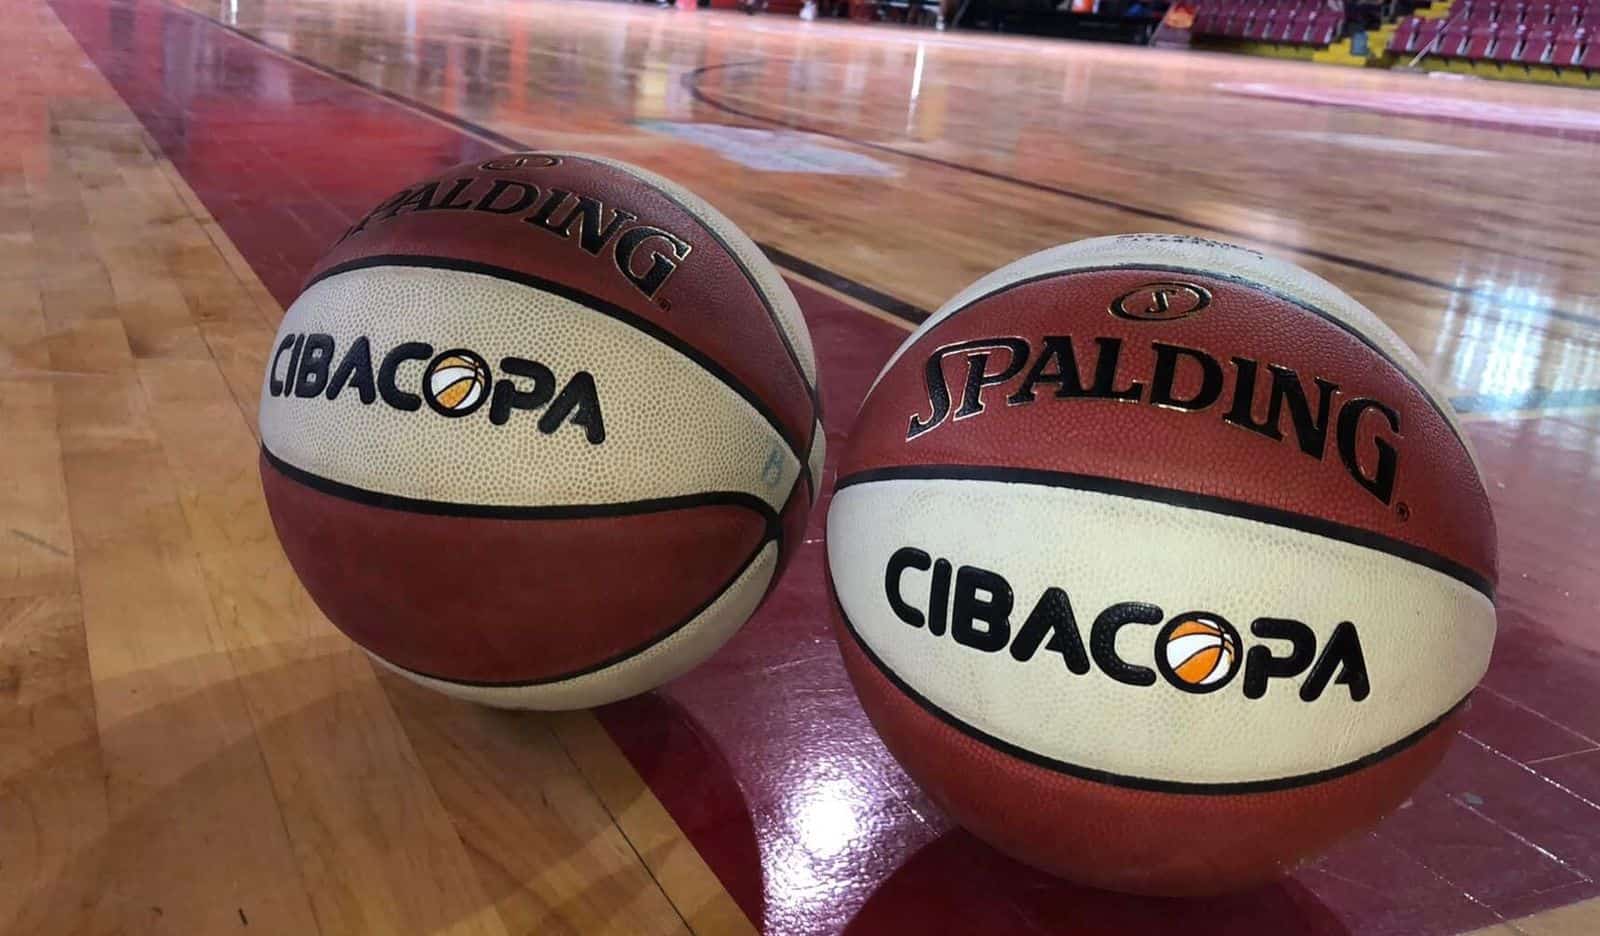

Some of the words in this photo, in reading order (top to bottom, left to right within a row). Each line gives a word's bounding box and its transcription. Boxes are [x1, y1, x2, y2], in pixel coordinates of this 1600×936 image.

[268, 333, 606, 445] CIBACOPA
[906, 335, 1401, 508] SPALDING
[884, 546, 1371, 702] CIBACOPA
